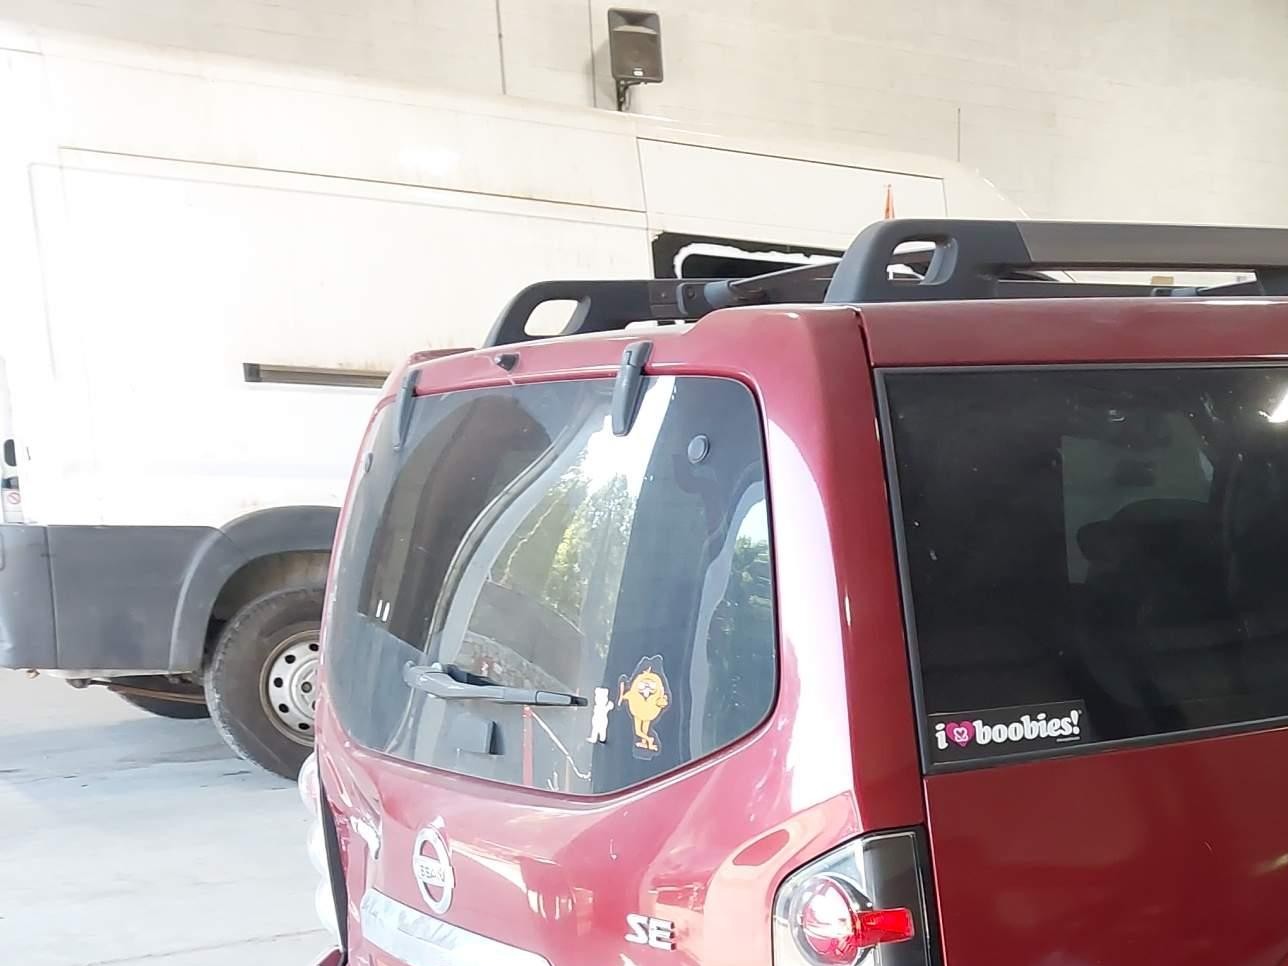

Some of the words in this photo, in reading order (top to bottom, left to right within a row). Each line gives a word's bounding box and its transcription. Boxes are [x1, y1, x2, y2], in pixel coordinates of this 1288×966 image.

[935, 723, 949, 750] i
[972, 709, 1080, 745] boobies!
[624, 912, 676, 951] SE
